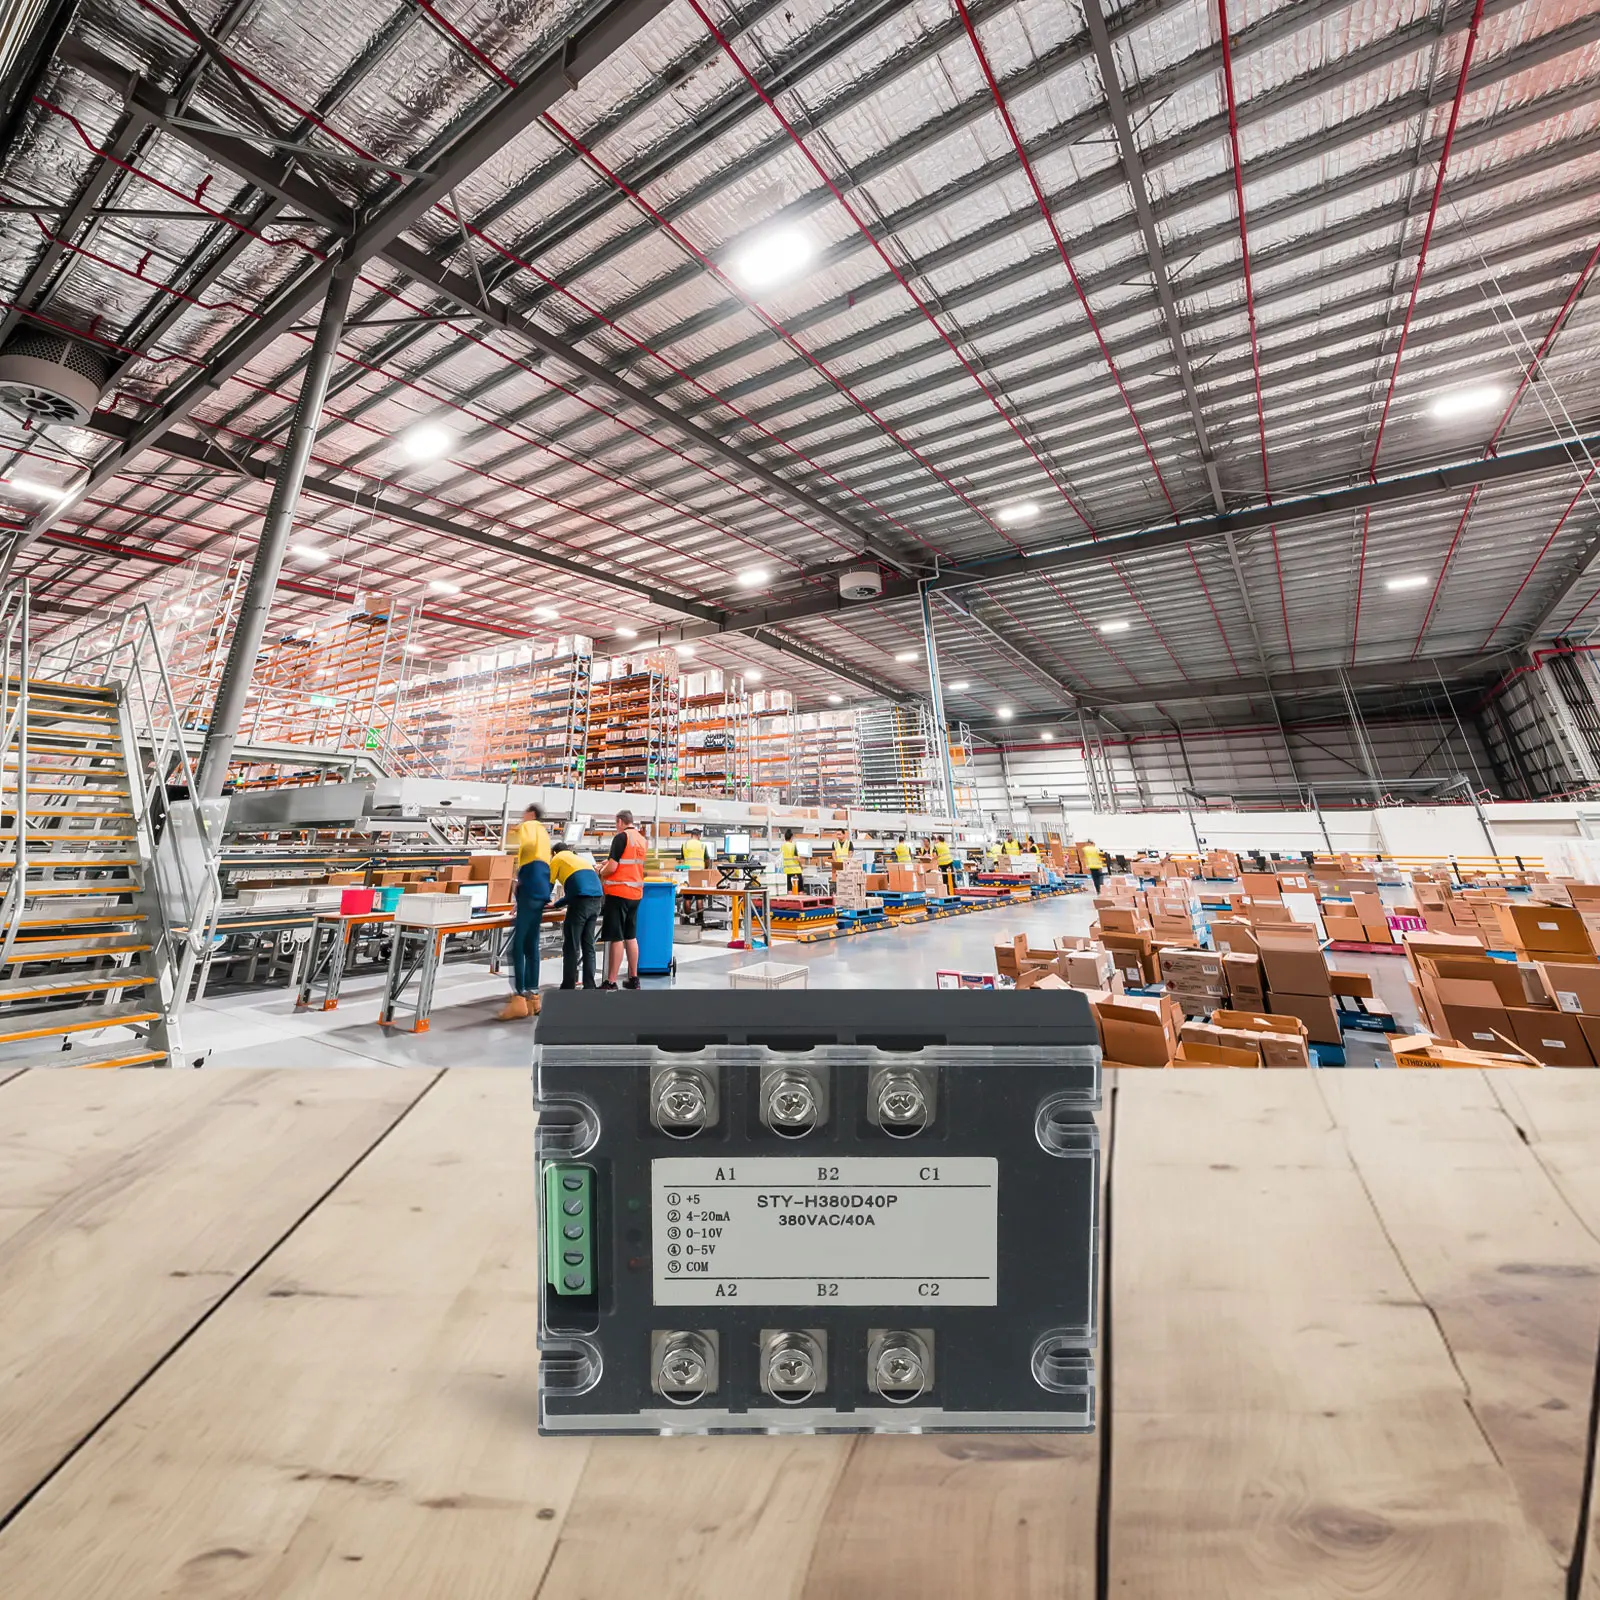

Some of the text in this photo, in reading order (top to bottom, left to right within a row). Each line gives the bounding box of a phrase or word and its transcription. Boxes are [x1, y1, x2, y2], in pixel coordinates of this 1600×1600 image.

[715, 1166, 941, 1181] A1 B2 C1
[686, 1193, 701, 1205] +5
[756, 1194, 898, 1209] STY-H380D40P
[686, 1210, 731, 1222] 4-20mA
[778, 1214, 876, 1227] 380VAC/40A
[686, 1227, 723, 1239] 0-10V
[686, 1244, 716, 1256] 0-5V
[686, 1261, 709, 1273] COM
[715, 1283, 940, 1297] A2 B2 C2
